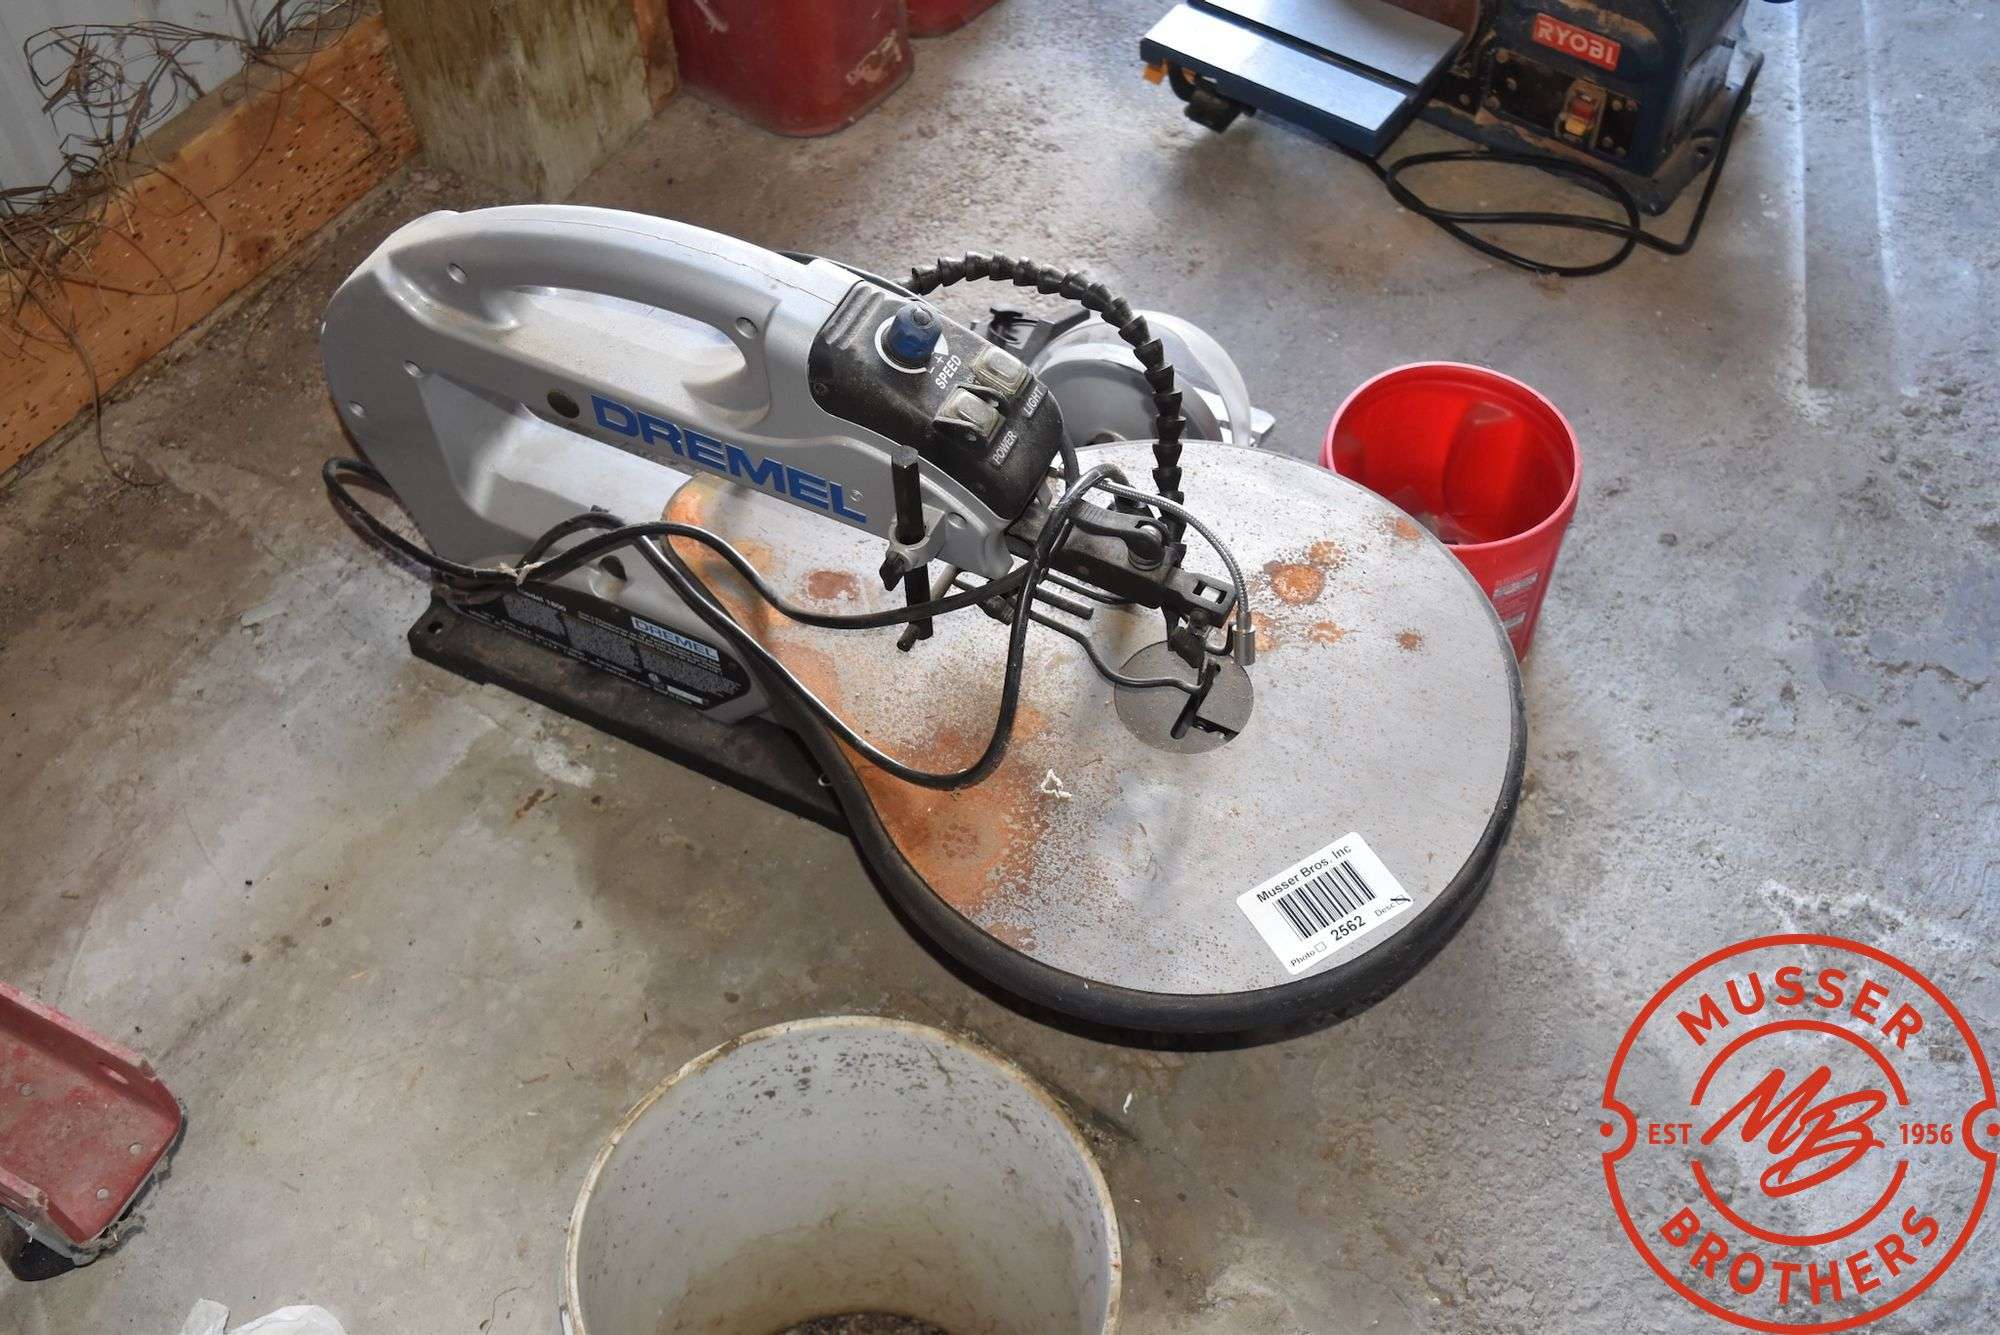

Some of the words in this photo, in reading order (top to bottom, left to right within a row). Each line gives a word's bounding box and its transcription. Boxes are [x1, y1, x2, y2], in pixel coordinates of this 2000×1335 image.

[1537, 19, 1616, 65] RYOBI
[935, 354, 962, 390] SPEED
[1023, 386, 1043, 418] LIGHT
[590, 393, 867, 524] DREMEL
[992, 430, 1018, 466] POWER
[635, 618, 717, 660] DREMEL
[1256, 873, 1300, 904] Musser
[1291, 950, 1316, 967] Photo
[1330, 915, 1366, 941] 2562
[1373, 902, 1395, 917] Desc
